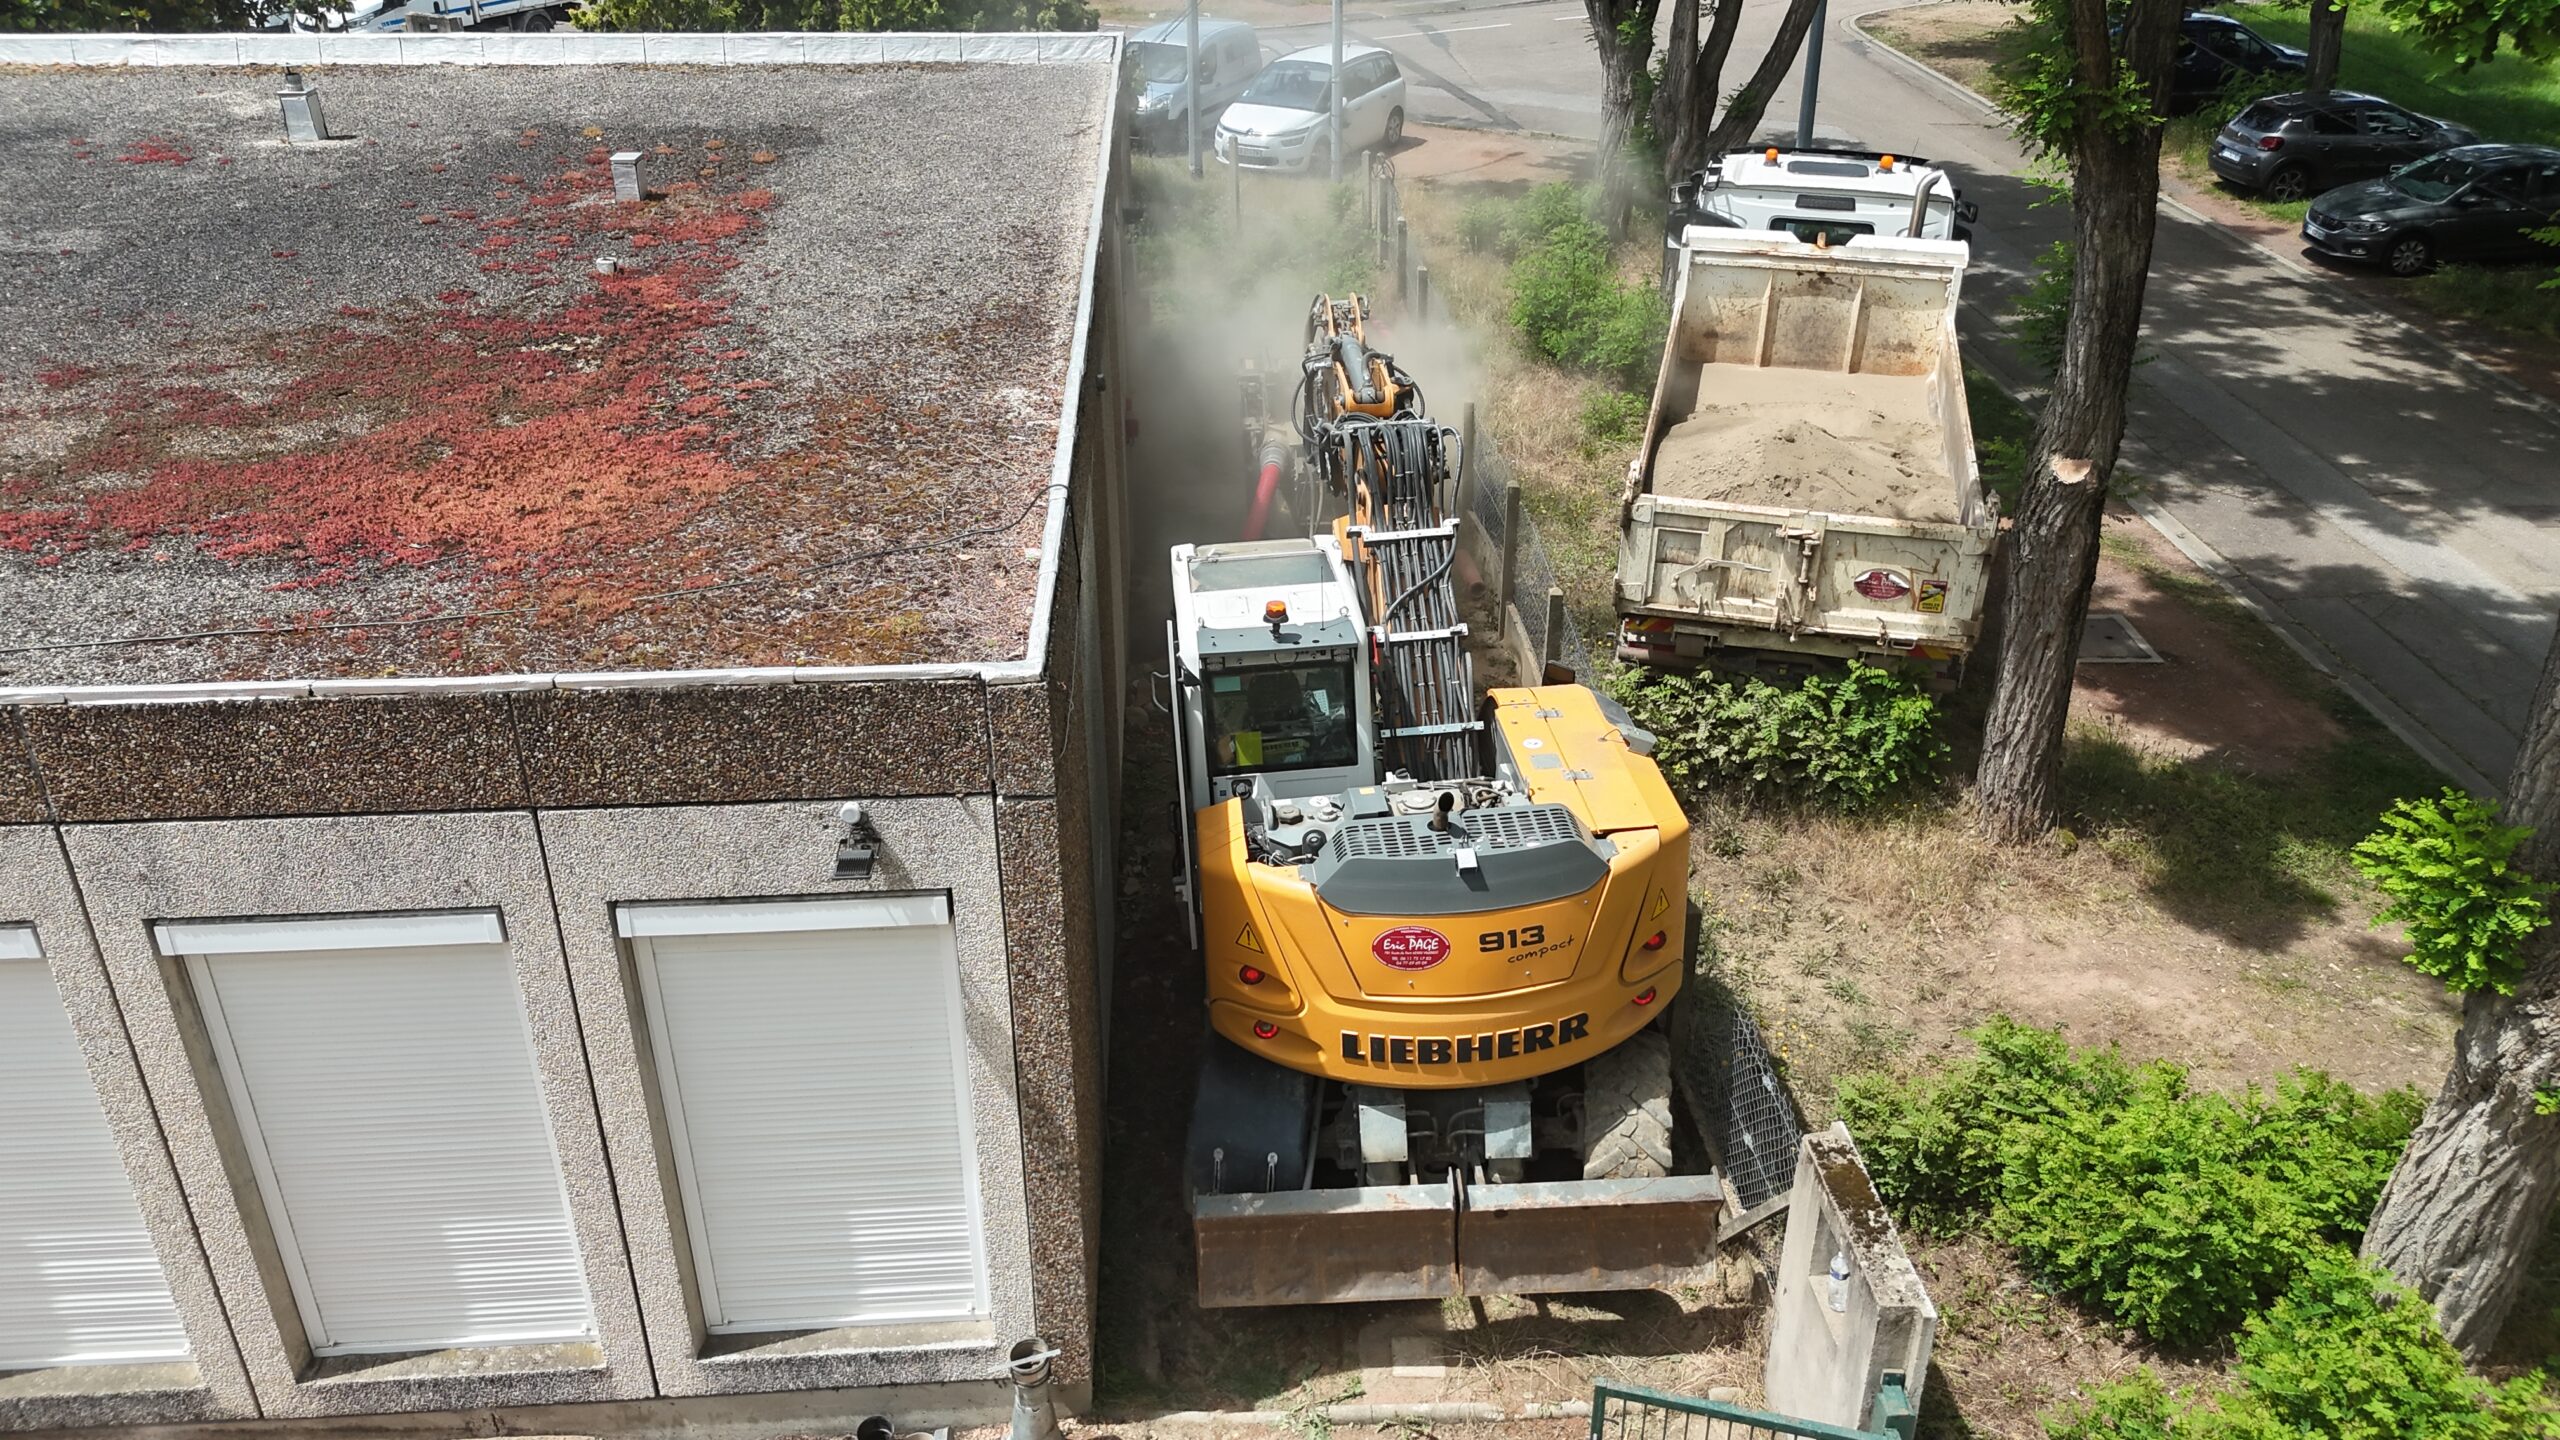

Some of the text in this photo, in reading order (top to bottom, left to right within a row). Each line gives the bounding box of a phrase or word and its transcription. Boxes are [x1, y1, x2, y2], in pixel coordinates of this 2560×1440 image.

[1383, 938, 1439, 951] Eric PAGE
[1479, 925, 1545, 952] 913
[1507, 934, 1575, 963] compact
[1341, 1011, 1590, 1064] LIEBHERR
